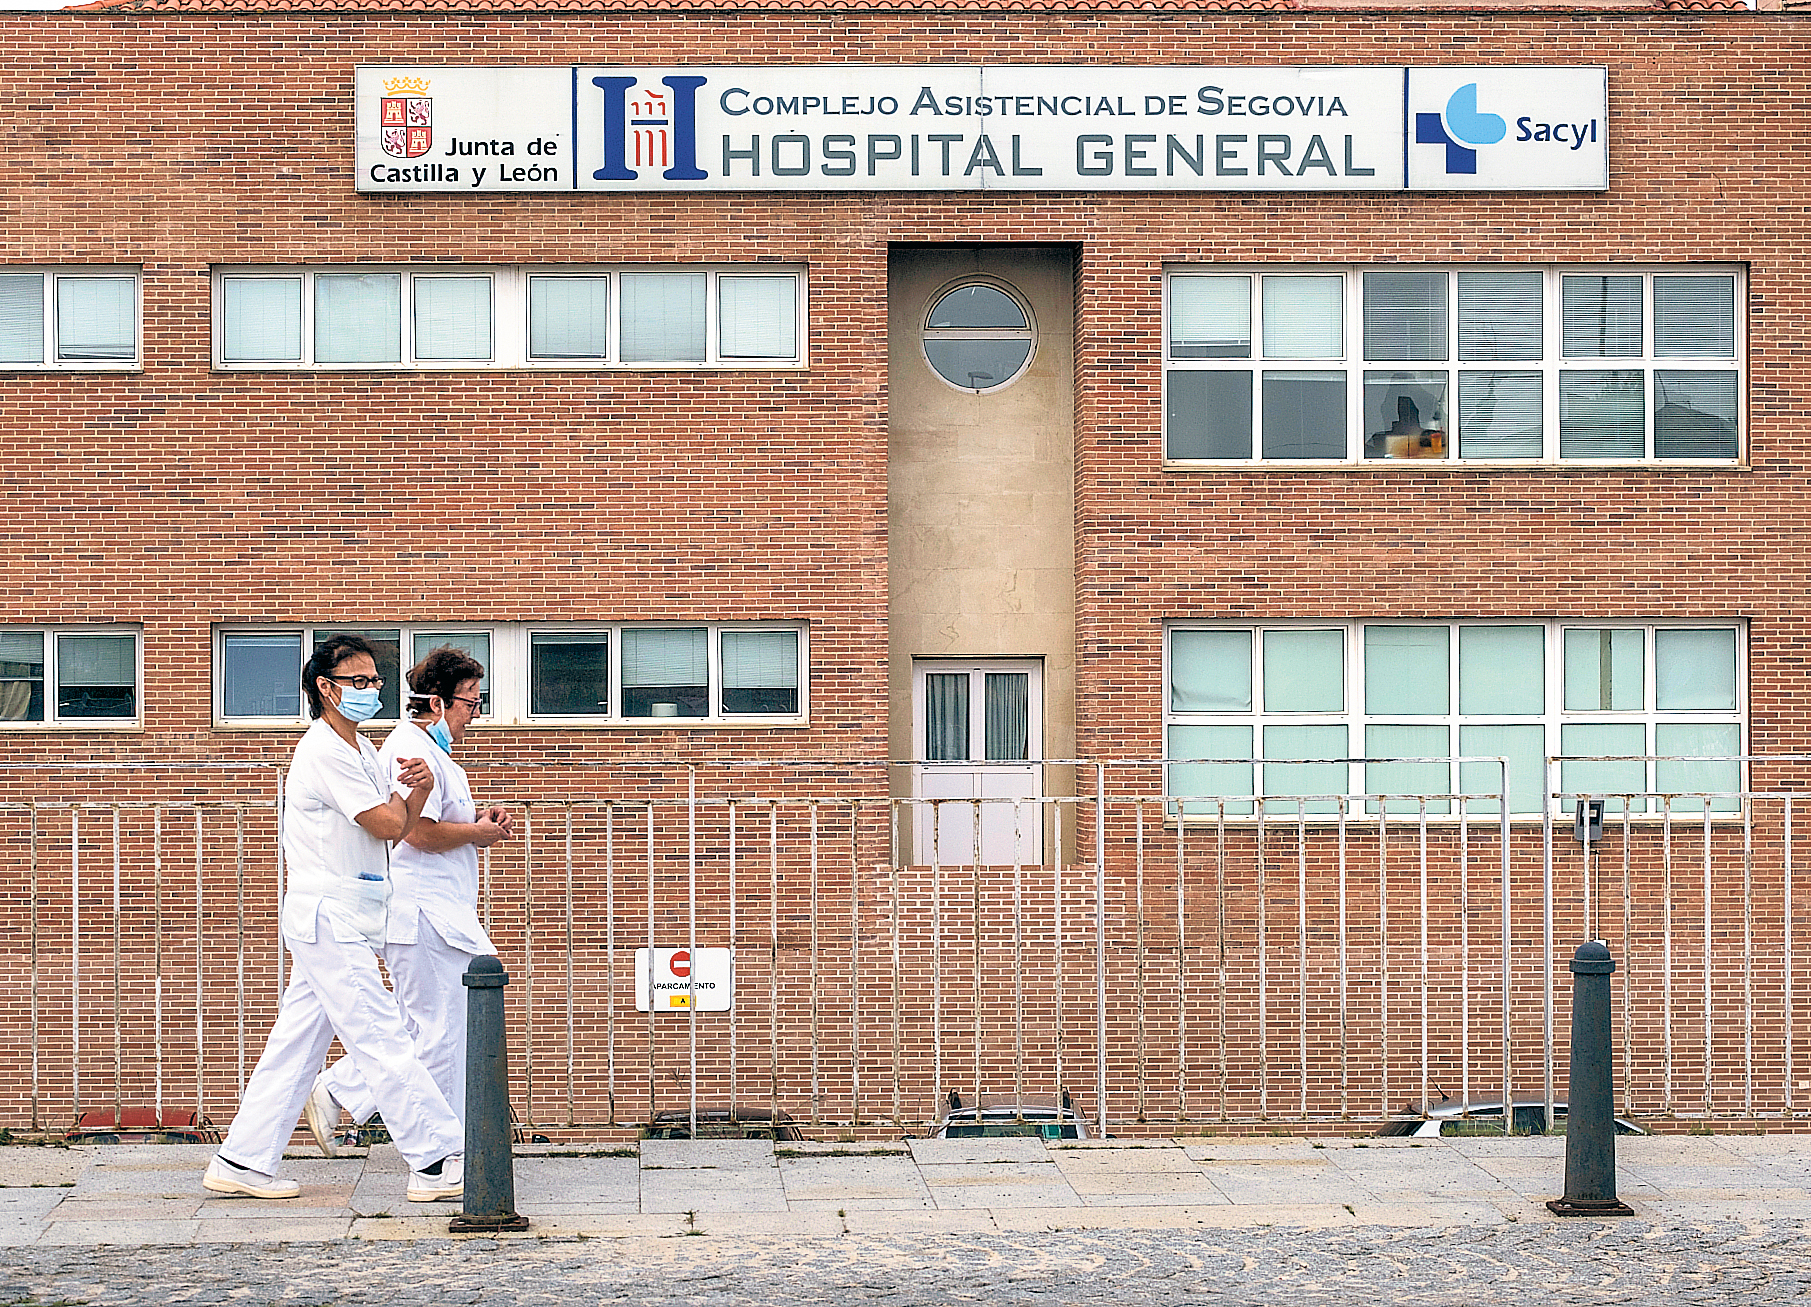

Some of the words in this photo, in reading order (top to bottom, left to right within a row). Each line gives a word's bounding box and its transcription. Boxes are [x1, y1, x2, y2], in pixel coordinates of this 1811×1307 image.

[719, 87, 899, 116] COMPLEJO
[908, 86, 1136, 117] ASISTENCIAL
[1144, 95, 1188, 116] DE
[1196, 85, 1349, 117] SEGOVIA
[444, 137, 515, 156] Junta
[526, 137, 558, 156] de
[1516, 116, 1597, 151] Sacyl
[722, 134, 1043, 177] HOSPITAL
[1076, 133, 1376, 177] GENERAL
[370, 163, 459, 183] Castilla
[471, 167, 487, 188] y
[499, 163, 558, 182] León
[652, 982, 716, 990] PARCAMENTO
